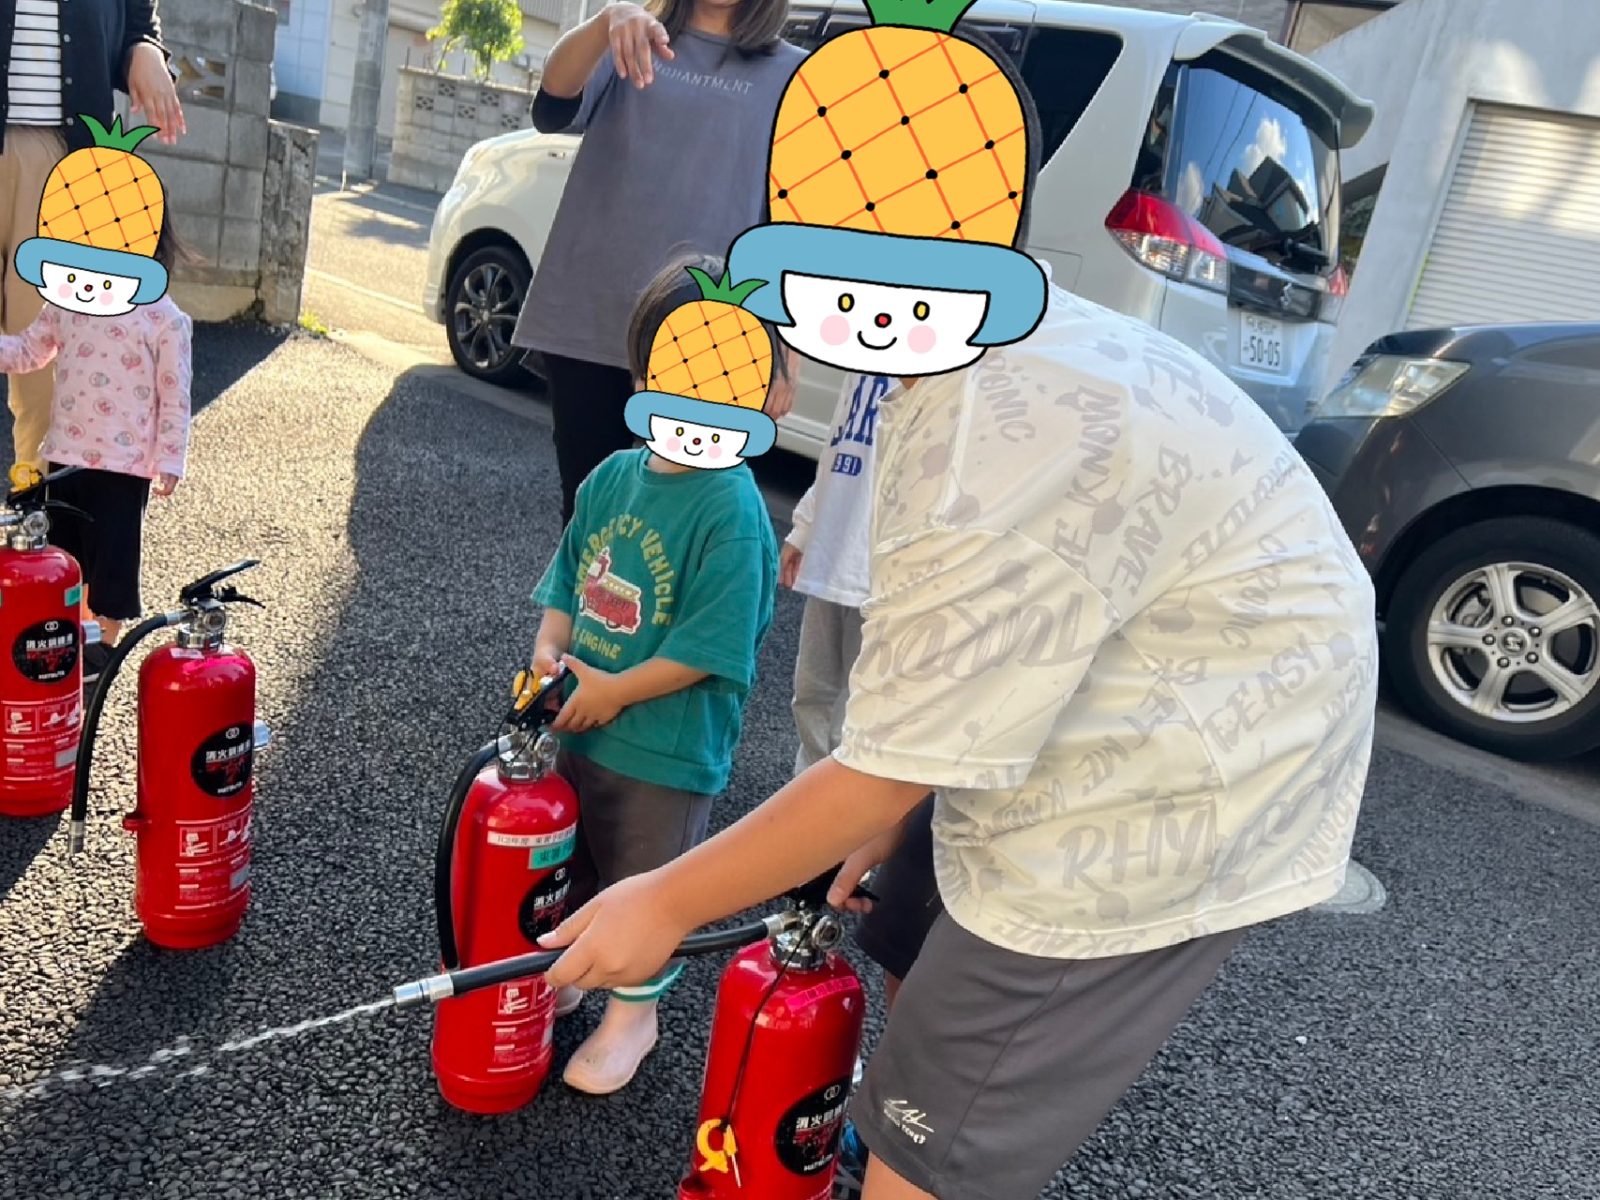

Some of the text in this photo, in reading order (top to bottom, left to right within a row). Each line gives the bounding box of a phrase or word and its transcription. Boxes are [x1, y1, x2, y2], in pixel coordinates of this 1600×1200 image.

[653, 61, 755, 96] NCHANTMENT
[1109, 446, 1194, 597] BRAVE
[640, 529, 675, 625] VEHICLE
